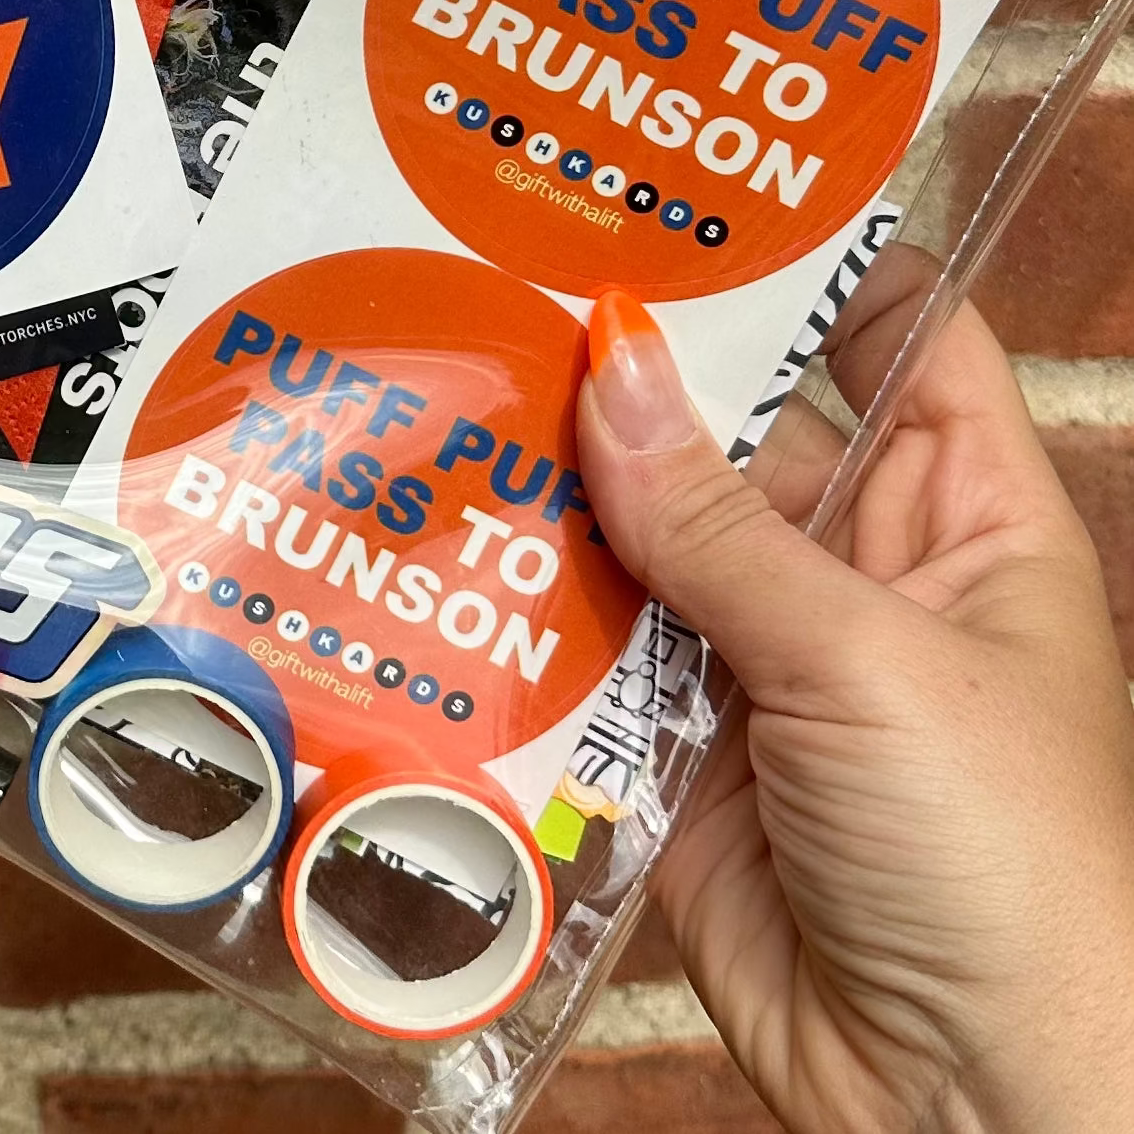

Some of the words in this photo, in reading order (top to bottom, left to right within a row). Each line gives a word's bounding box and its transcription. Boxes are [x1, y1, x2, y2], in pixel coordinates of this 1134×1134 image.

[717, 31, 828, 122] TO
[428, 86, 724, 242] KUSHKARDS
[494, 158, 626, 235] @giftwithalift
[213, 310, 428, 439] PUFF
[434, 417, 604, 546] PUF
[228, 401, 433, 535] PASS
[457, 505, 559, 595] TO
[164, 453, 560, 685] BRUNSON
[183, 564, 470, 717] KUSHKARDS
[248, 636, 374, 710] @giftwithalift
